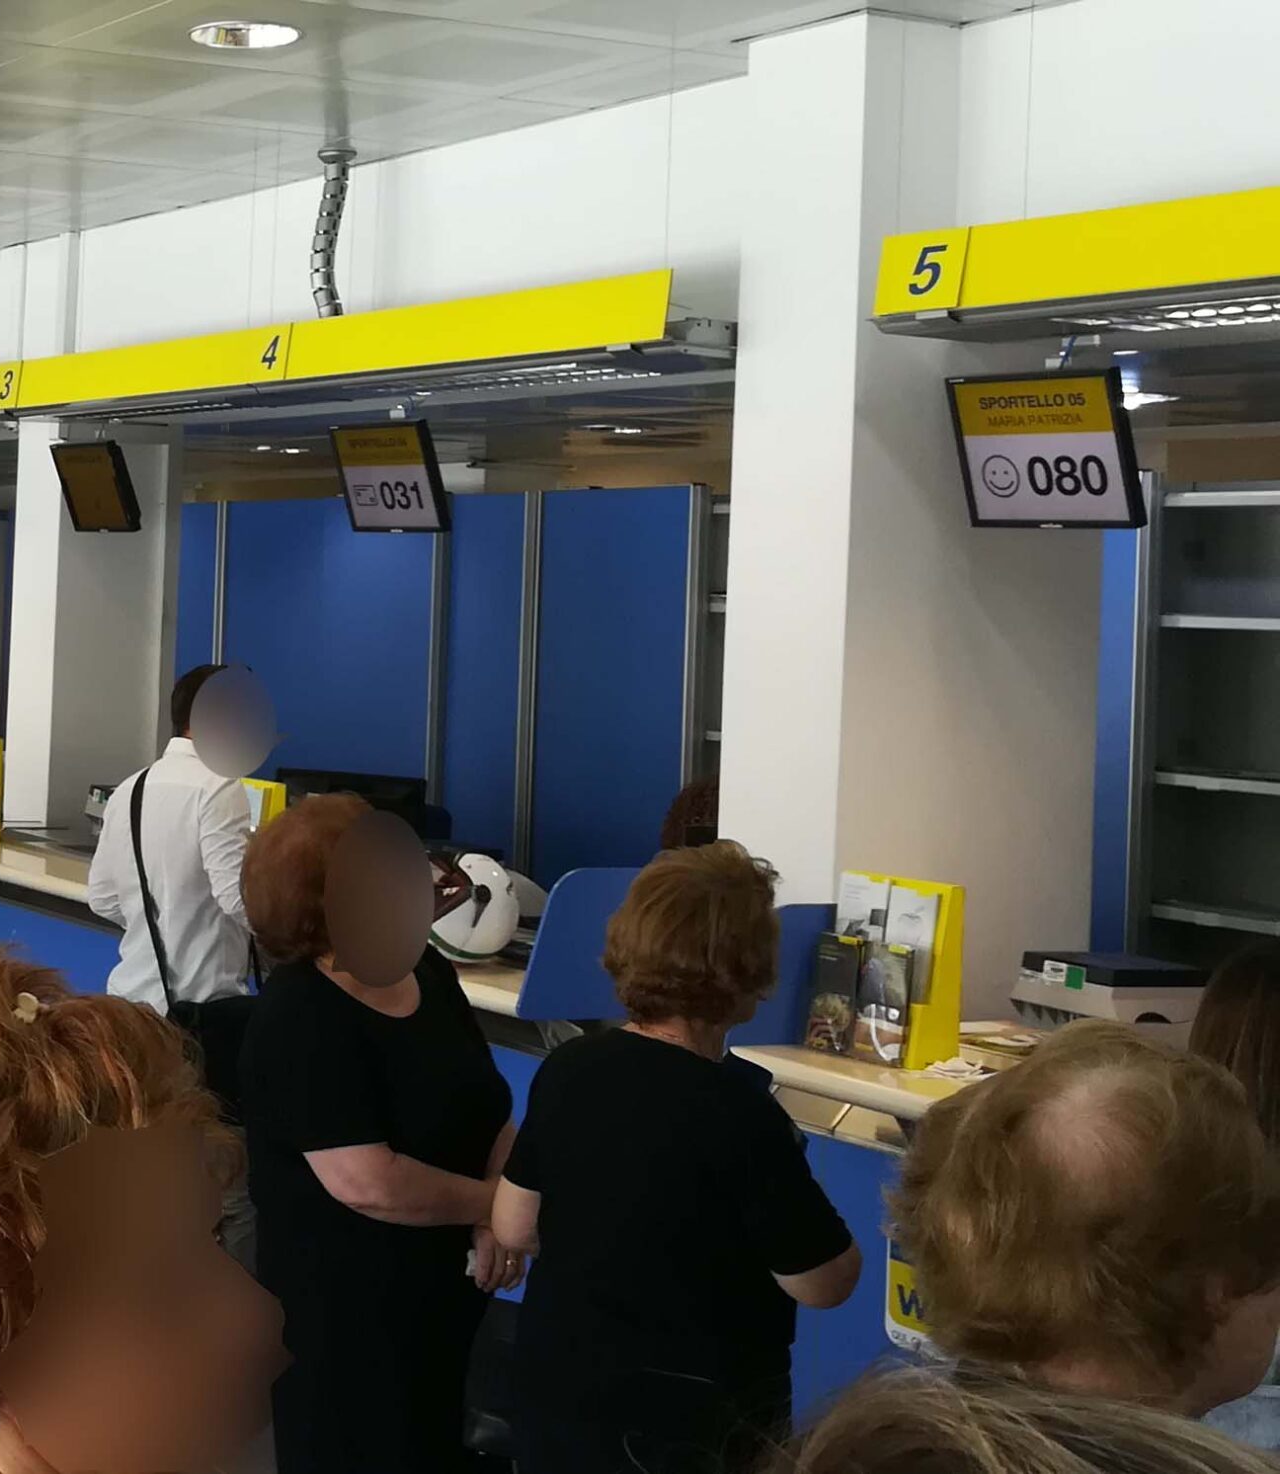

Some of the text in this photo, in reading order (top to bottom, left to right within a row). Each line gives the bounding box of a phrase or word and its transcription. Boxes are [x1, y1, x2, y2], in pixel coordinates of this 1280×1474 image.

[908, 244, 948, 296] 5
[261, 335, 280, 370] 4
[0, 369, 14, 400] 3
[978, 393, 1087, 410] SPORTELLO 05
[987, 413, 1083, 428] MARIA PATRIZIA
[1027, 455, 1108, 497] 080
[380, 480, 424, 510] 031
